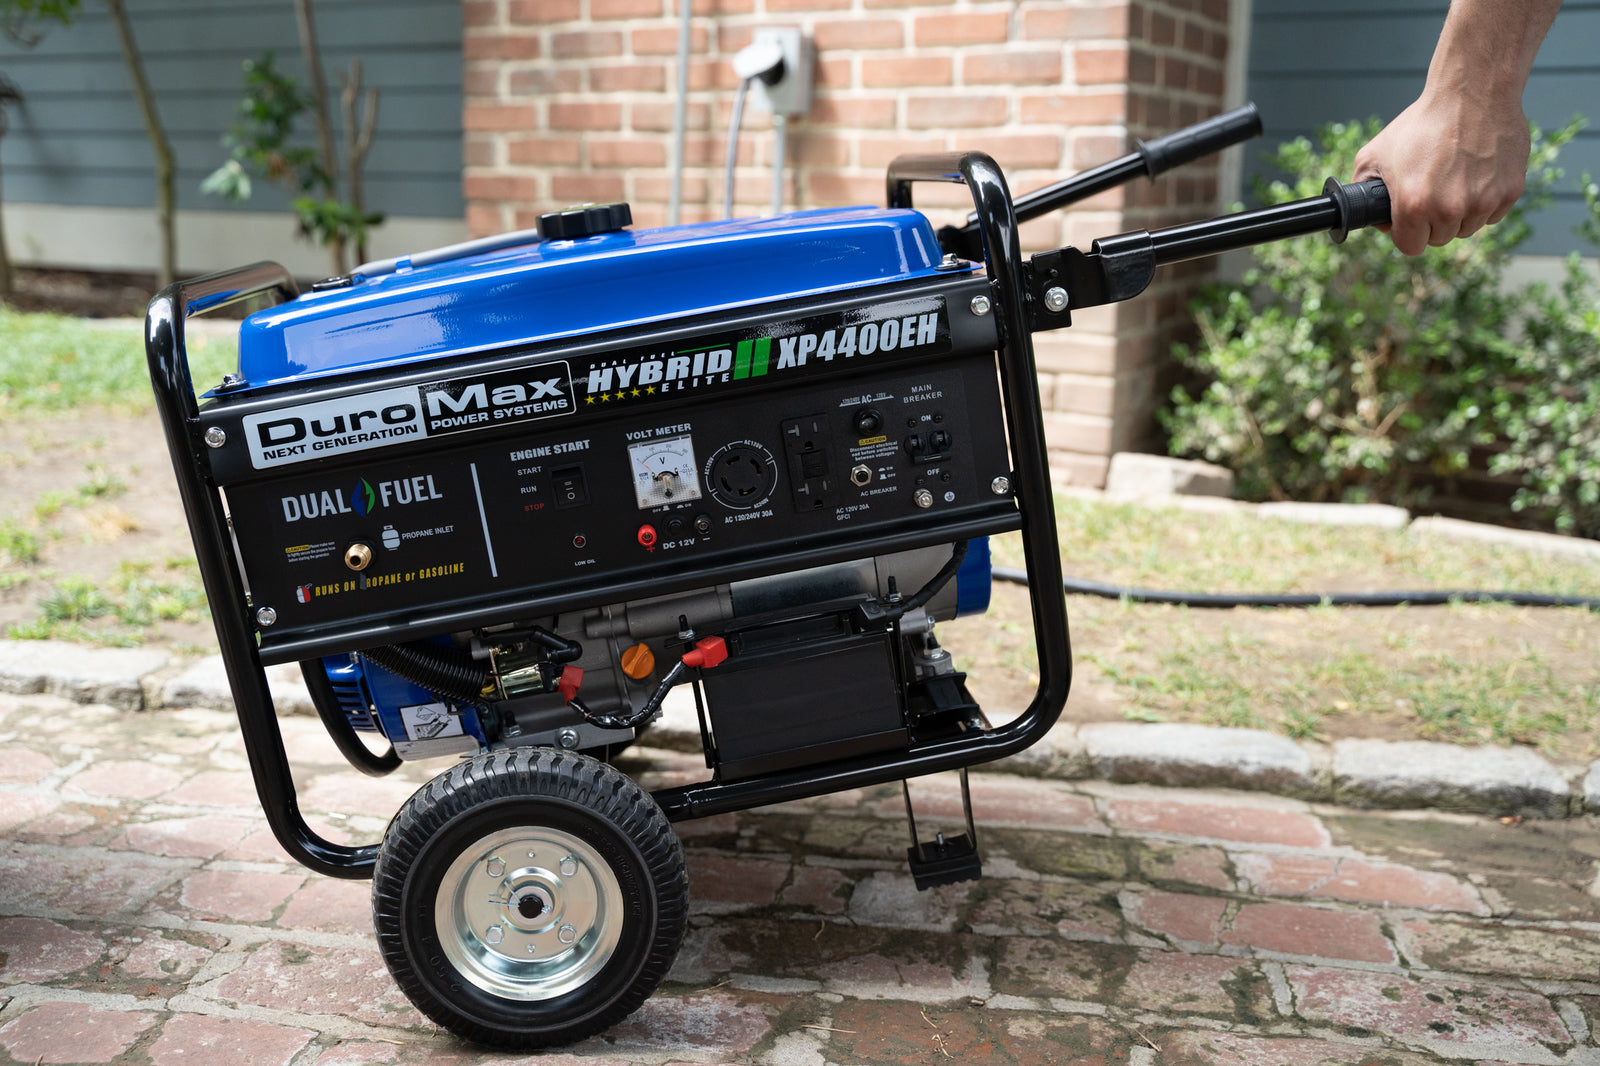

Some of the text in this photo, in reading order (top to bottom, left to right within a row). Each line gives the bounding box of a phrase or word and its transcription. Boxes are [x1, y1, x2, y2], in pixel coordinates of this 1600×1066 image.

[587, 349, 732, 394] HYBRID
[776, 312, 938, 370] XP4400EH
[590, 351, 676, 368] DUAL FUEL
[661, 372, 730, 392] ELITE
[911, 384, 932, 393] MAIN
[861, 394, 872, 404] AC
[903, 391, 943, 404] BREAKER
[263, 398, 568, 460] NEXT GENERATION POWER SYSTEMS
[626, 423, 692, 441] VOLT METER
[510, 440, 590, 461] ENGINE START
[517, 466, 542, 476] START
[520, 486, 537, 494] RUN
[870, 486, 897, 496] BREAKER
[281, 474, 443, 523] DUAL FUEL
[524, 503, 544, 512] STOP
[734, 512, 760, 522] 120/240V
[401, 525, 454, 540] PROPANE INLET
[662, 538, 695, 550] DC 12V
[315, 562, 465, 597] RUNS ON ROPANE or GASOLINE
